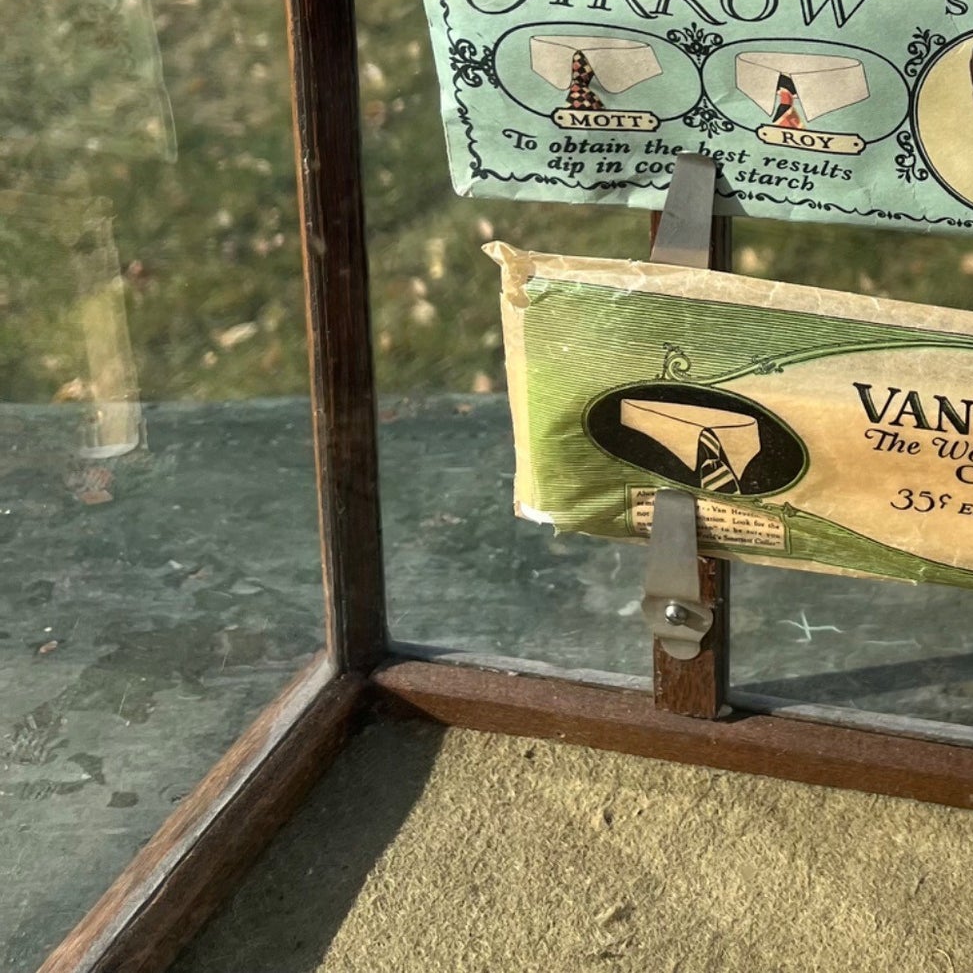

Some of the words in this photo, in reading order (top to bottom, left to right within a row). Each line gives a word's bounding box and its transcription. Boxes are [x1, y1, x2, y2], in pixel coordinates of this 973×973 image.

[569, 113, 643, 127] MOTT
[502, 128, 538, 151] To
[549, 136, 631, 154] obtain
[644, 138, 683, 155] the
[698, 141, 751, 164] best
[762, 155, 853, 180] results
[781, 131, 835, 149] ROY
[547, 156, 585, 178] dip
[596, 157, 623, 174] in
[734, 168, 815, 191] starch
[864, 427, 921, 456] The
